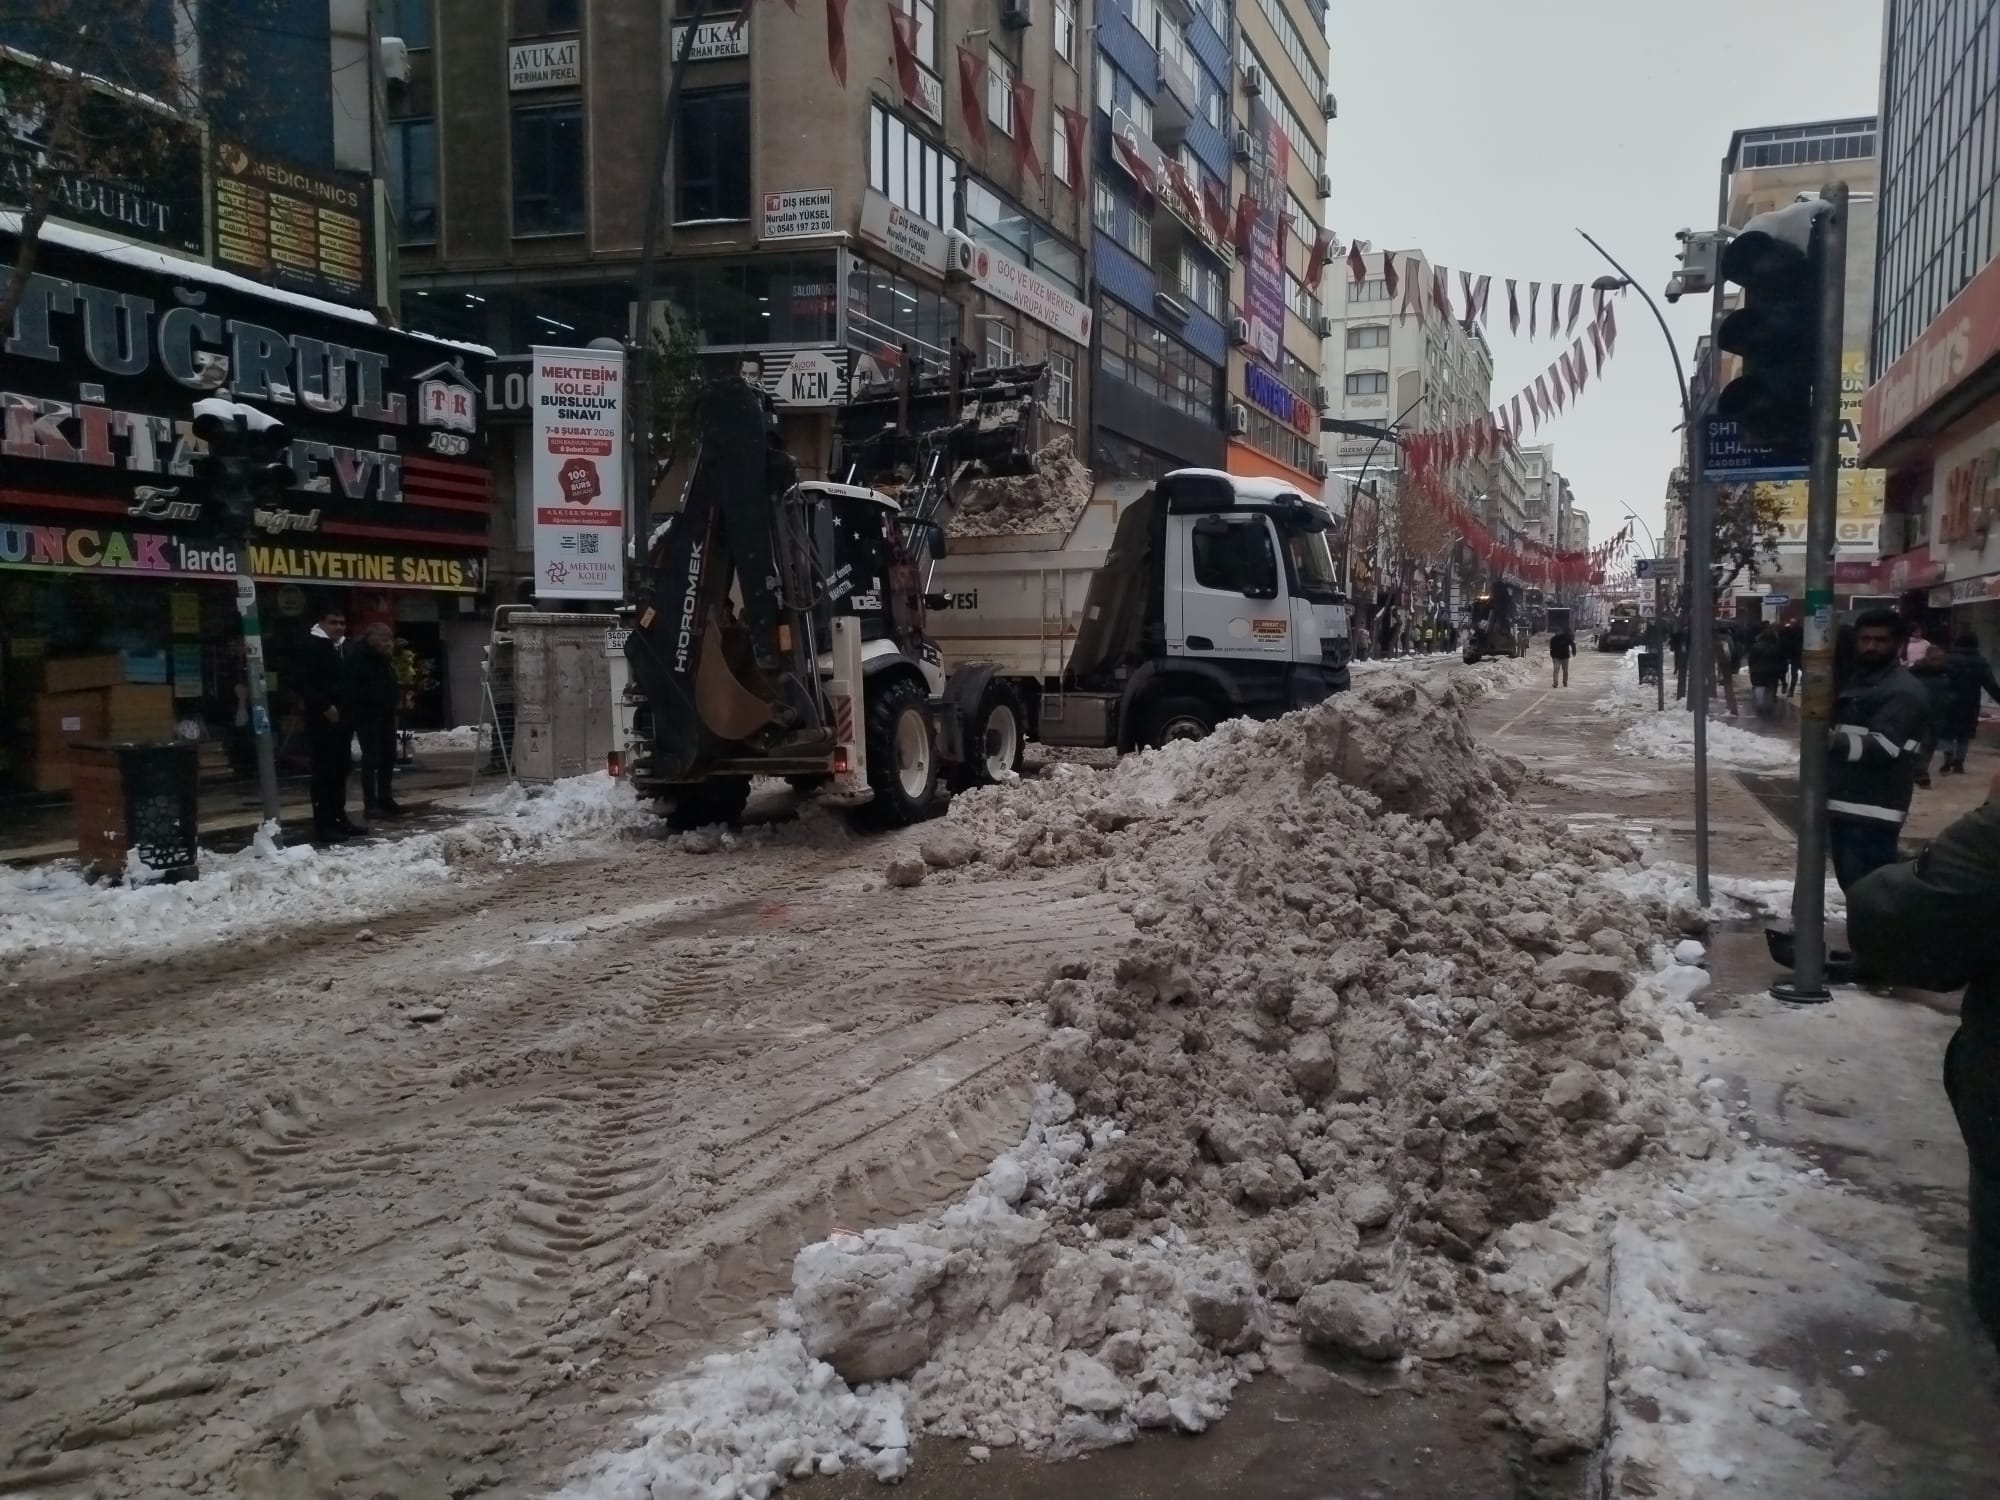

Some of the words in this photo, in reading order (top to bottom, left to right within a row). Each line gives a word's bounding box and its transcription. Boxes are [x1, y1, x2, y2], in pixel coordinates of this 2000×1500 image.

[715, 43, 740, 55] PEKEL
[513, 45, 576, 70] AVUKAT
[551, 67, 576, 80] PEKEL
[782, 198, 797, 208] DİŞ
[799, 194, 830, 206] HEKİMİ
[766, 210, 797, 223] Nurullah
[799, 209, 830, 220] YÜKSEL
[777, 224, 794, 233] 0545
[797, 223, 809, 232] 197
[811, 222, 820, 231] 23
[821, 221, 831, 230] 00
[1017, 271, 1027, 289] VE
[1013, 290, 1043, 318] AVRUPA
[1, 266, 407, 424] TUĞRUL
[542, 366, 617, 382] MEKTEBİM
[554, 382, 605, 397] KOLEJİ
[791, 371, 828, 400] MEN
[541, 395, 617, 410] BURSLULUK
[558, 409, 601, 421] SINAVI
[561, 427, 592, 436] ŞUBAT
[593, 429, 615, 437] 2026
[2, 383, 402, 502] KİTAEVİ
[429, 431, 469, 456] 1950
[402, 556, 463, 590] SATIŞ
[569, 562, 615, 571] MEKTEBİM
